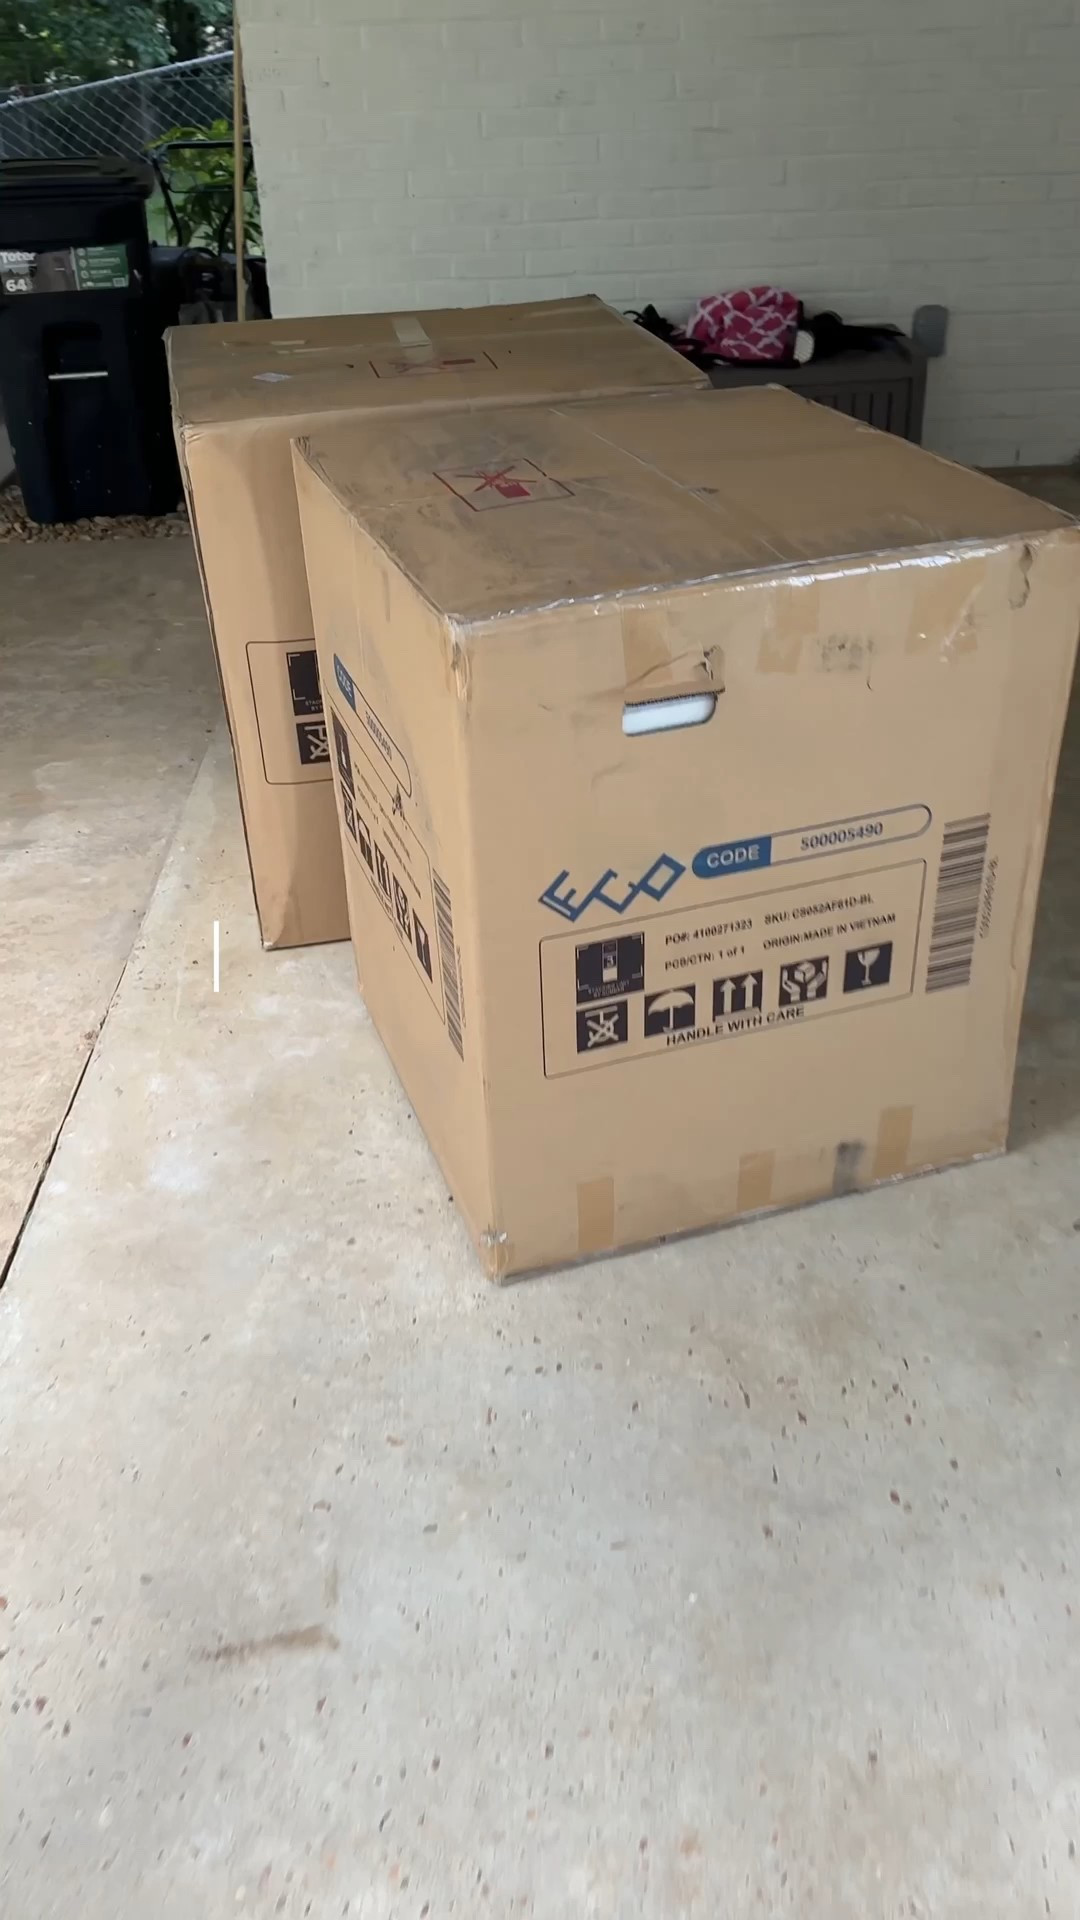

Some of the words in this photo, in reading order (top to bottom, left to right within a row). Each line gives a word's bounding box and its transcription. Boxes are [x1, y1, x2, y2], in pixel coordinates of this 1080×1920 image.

[6, 279, 27, 292] 64
[707, 845, 760, 869] CODE
[837, 923, 847, 934] IN
[849, 913, 896, 931] VIETNAM
[666, 1023, 724, 1046] HANDLE
[728, 1015, 763, 1033] WITH
[766, 1006, 804, 1024] CARE
